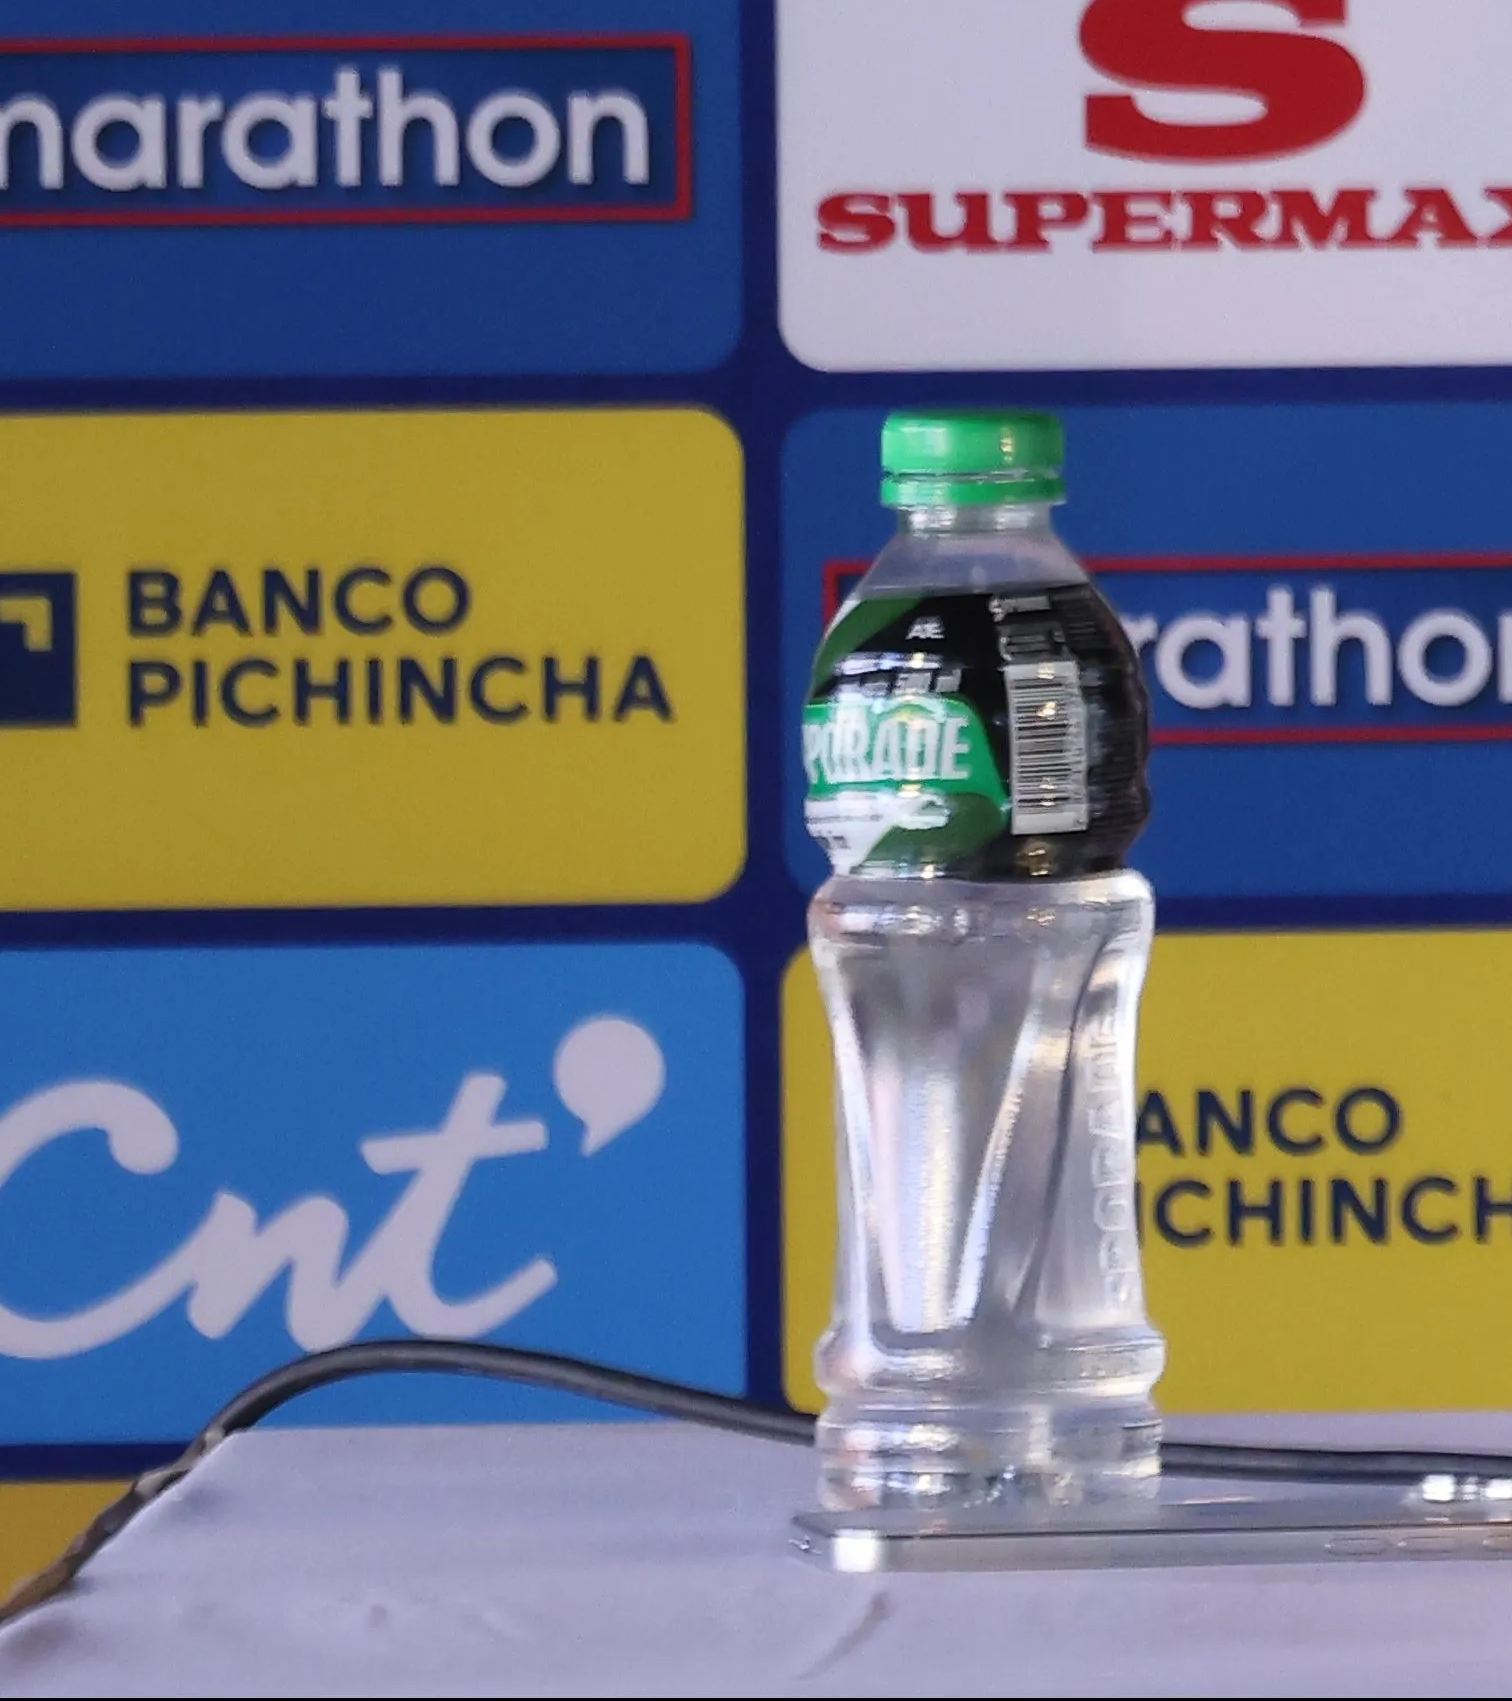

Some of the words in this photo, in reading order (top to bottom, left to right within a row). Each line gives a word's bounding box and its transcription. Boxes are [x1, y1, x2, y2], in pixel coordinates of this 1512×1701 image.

[126, 565, 472, 638] BANCO
[126, 654, 677, 728] PICHINCHA
[1135, 1086, 1404, 1157] ANCO
